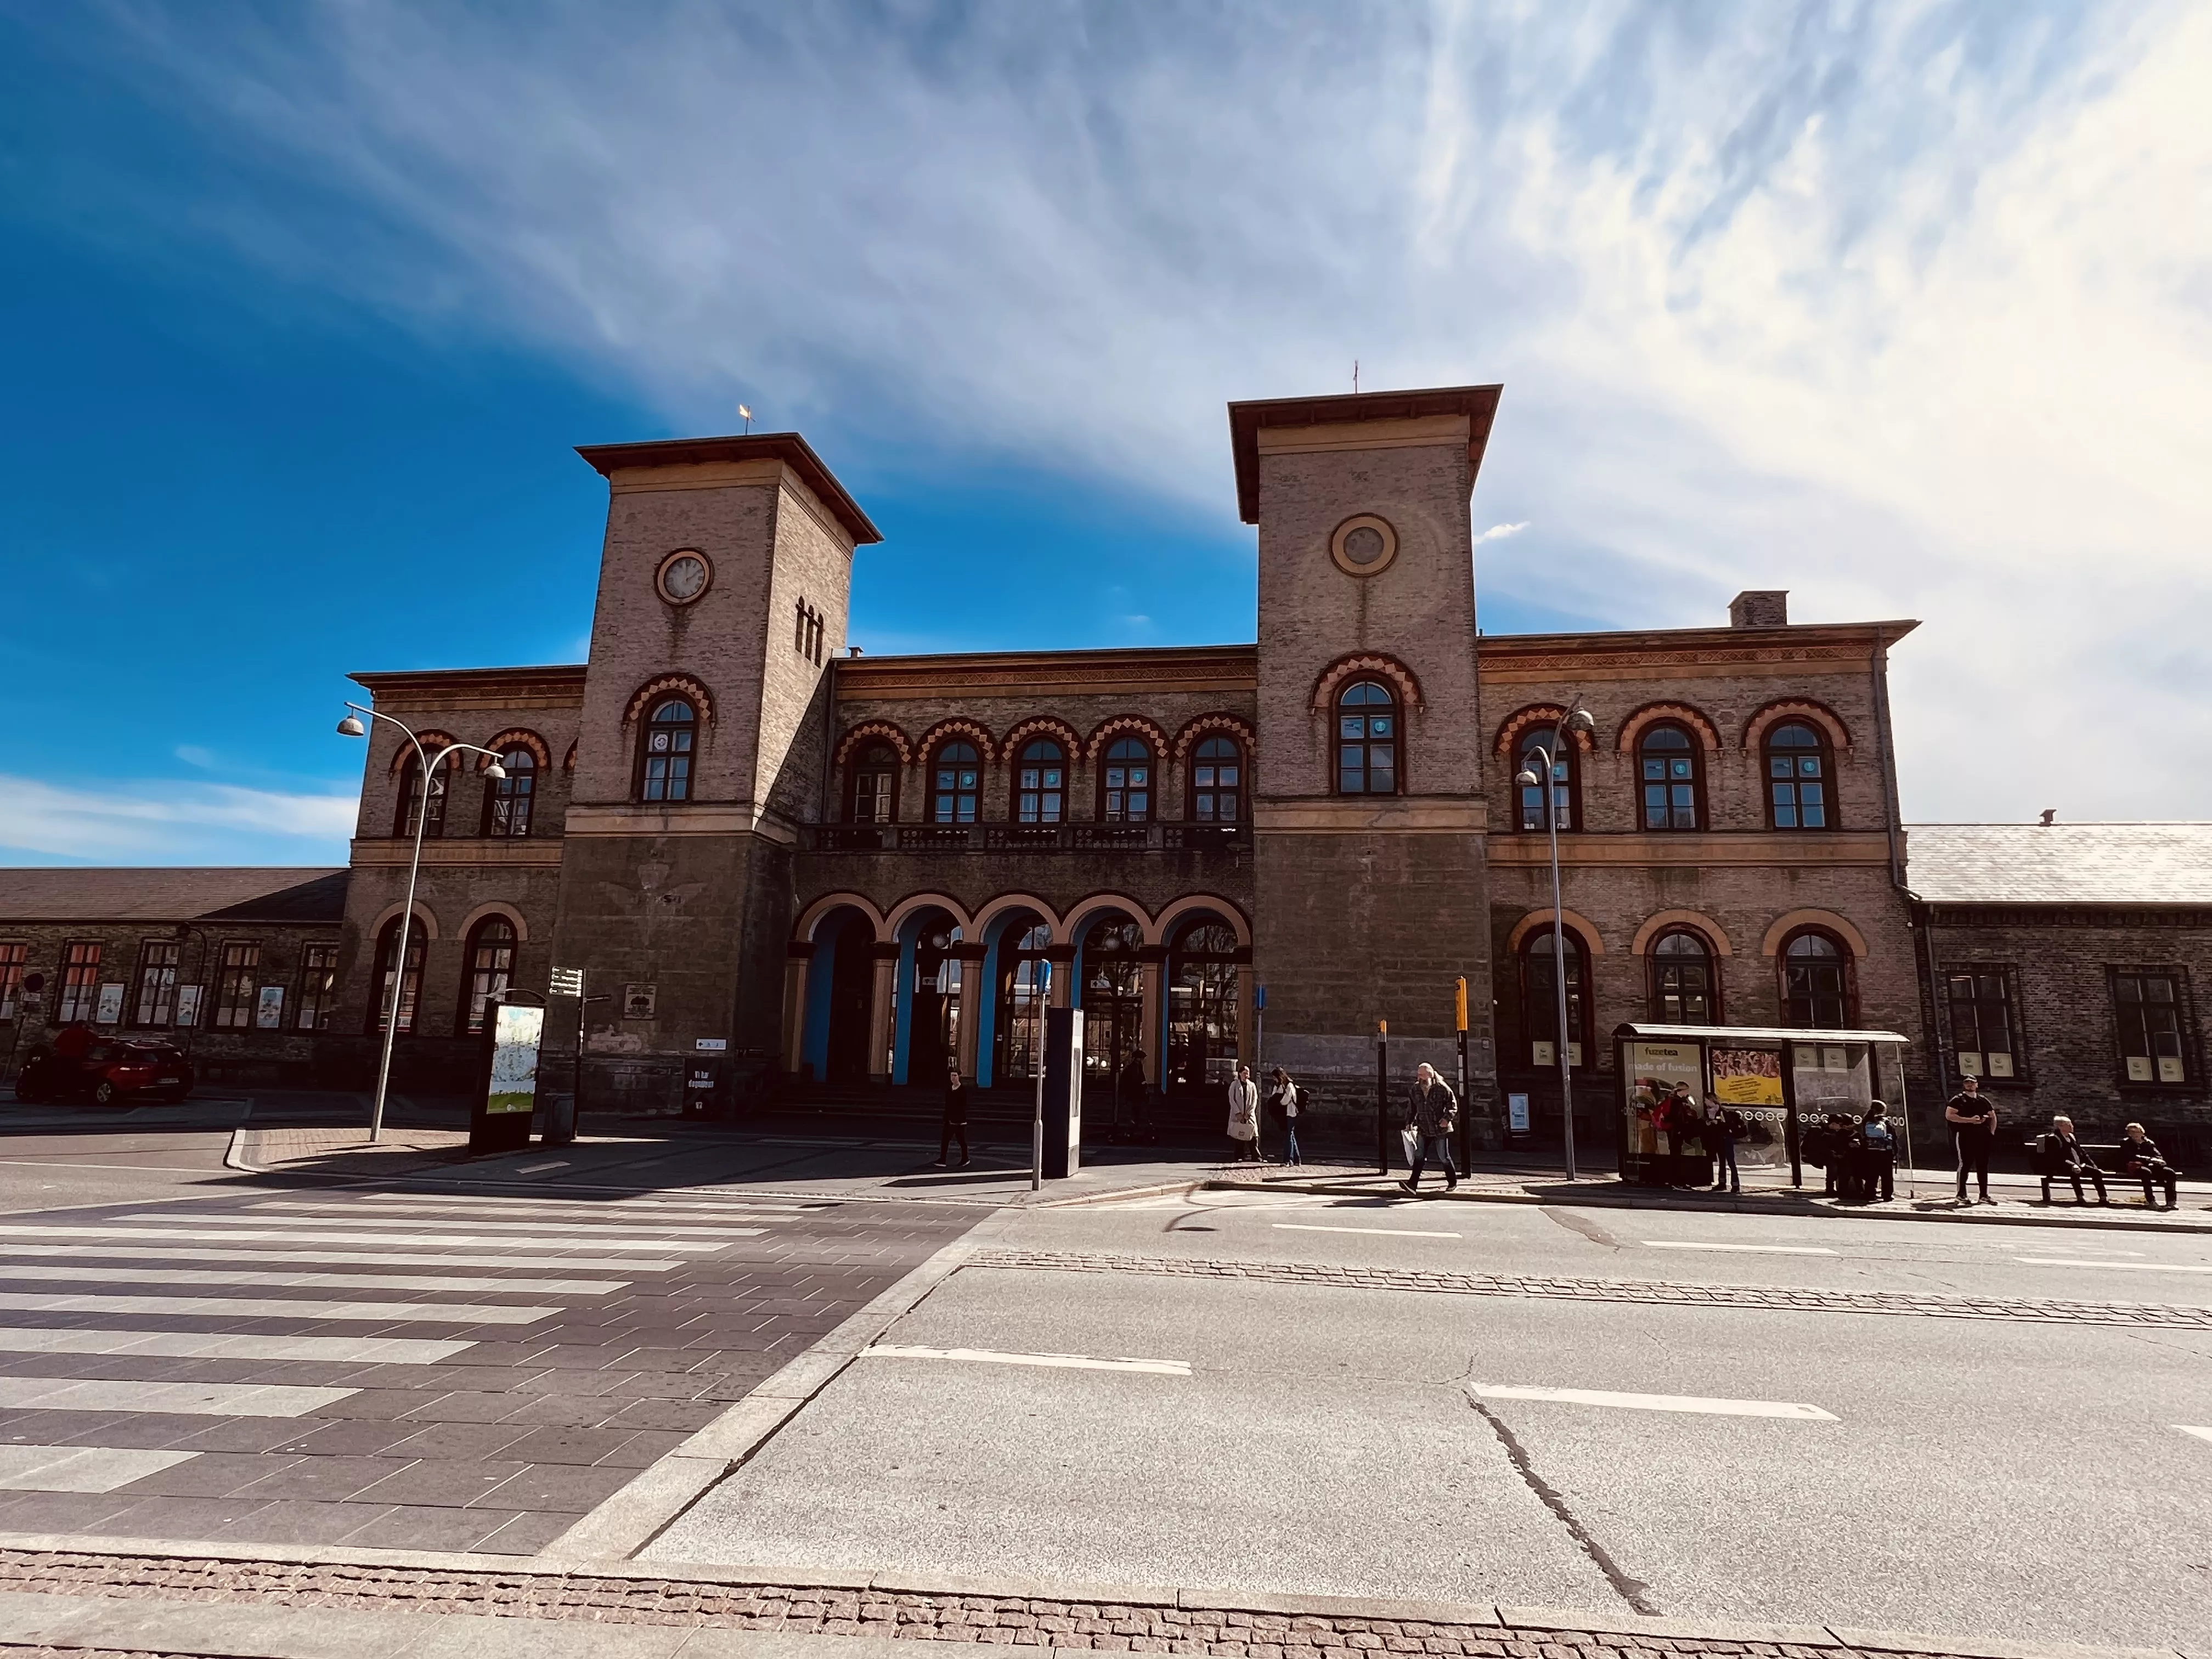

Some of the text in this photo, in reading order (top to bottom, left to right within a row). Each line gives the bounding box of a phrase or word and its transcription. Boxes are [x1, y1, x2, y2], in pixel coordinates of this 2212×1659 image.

[1645, 1047, 1678, 1056] fuzetea
[1628, 1062, 1697, 1072] made of fusion
